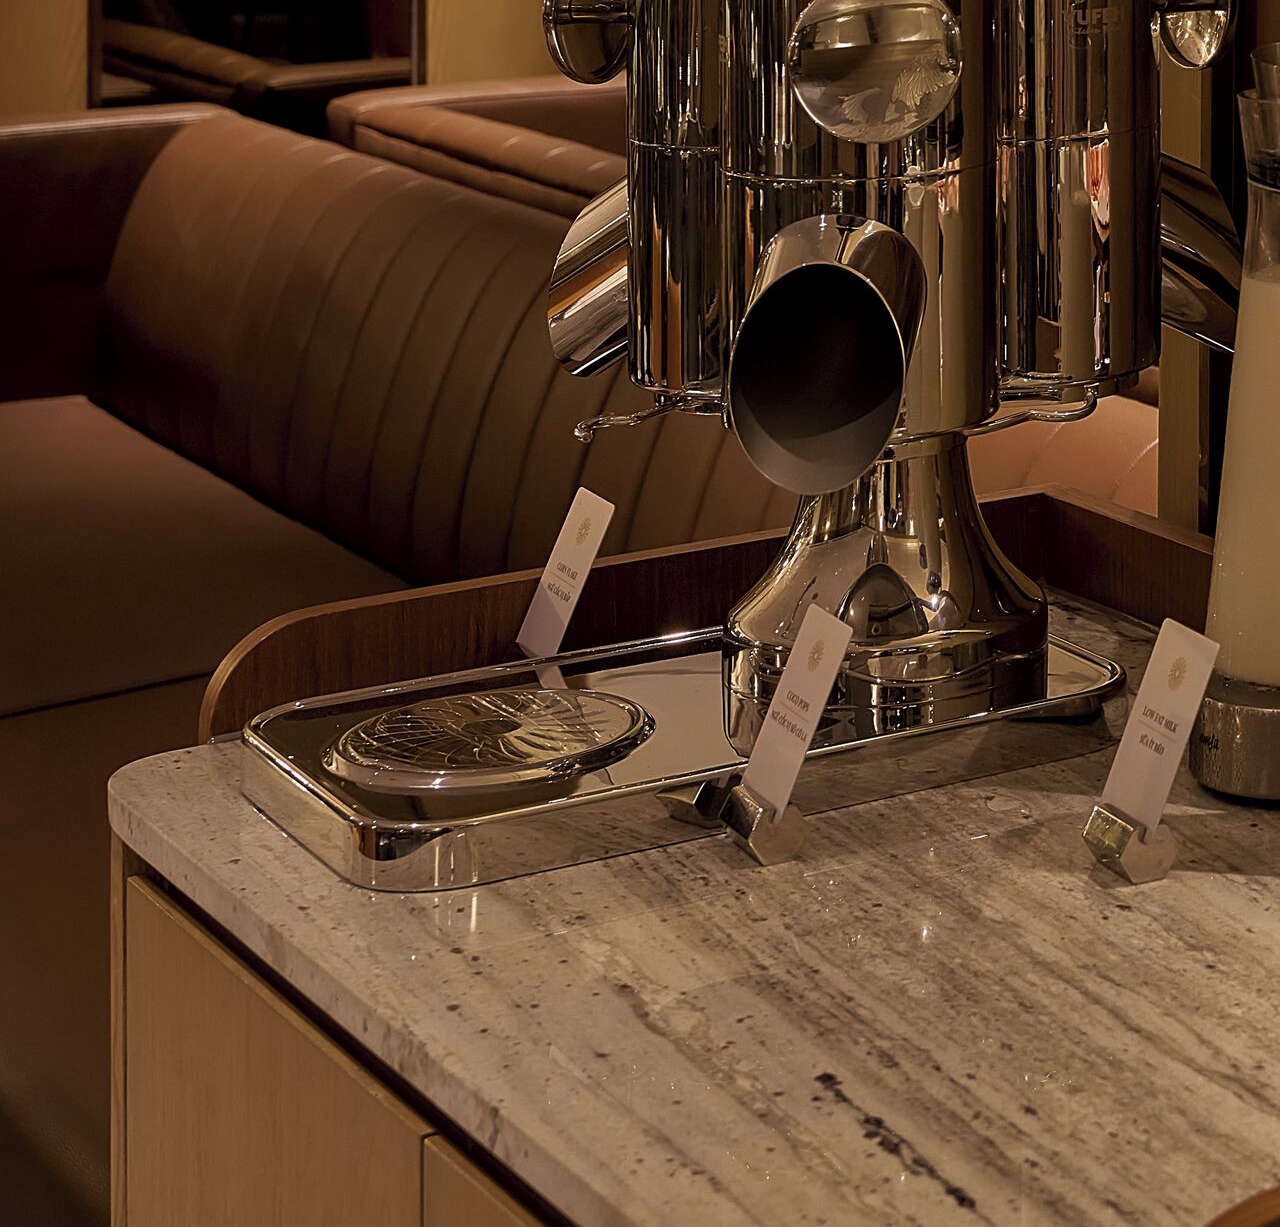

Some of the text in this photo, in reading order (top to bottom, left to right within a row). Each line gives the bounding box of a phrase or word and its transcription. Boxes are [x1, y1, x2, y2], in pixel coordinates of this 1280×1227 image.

[787, 690, 799, 706] COCO
[1142, 706, 1178, 733] LOW FAT MILK
